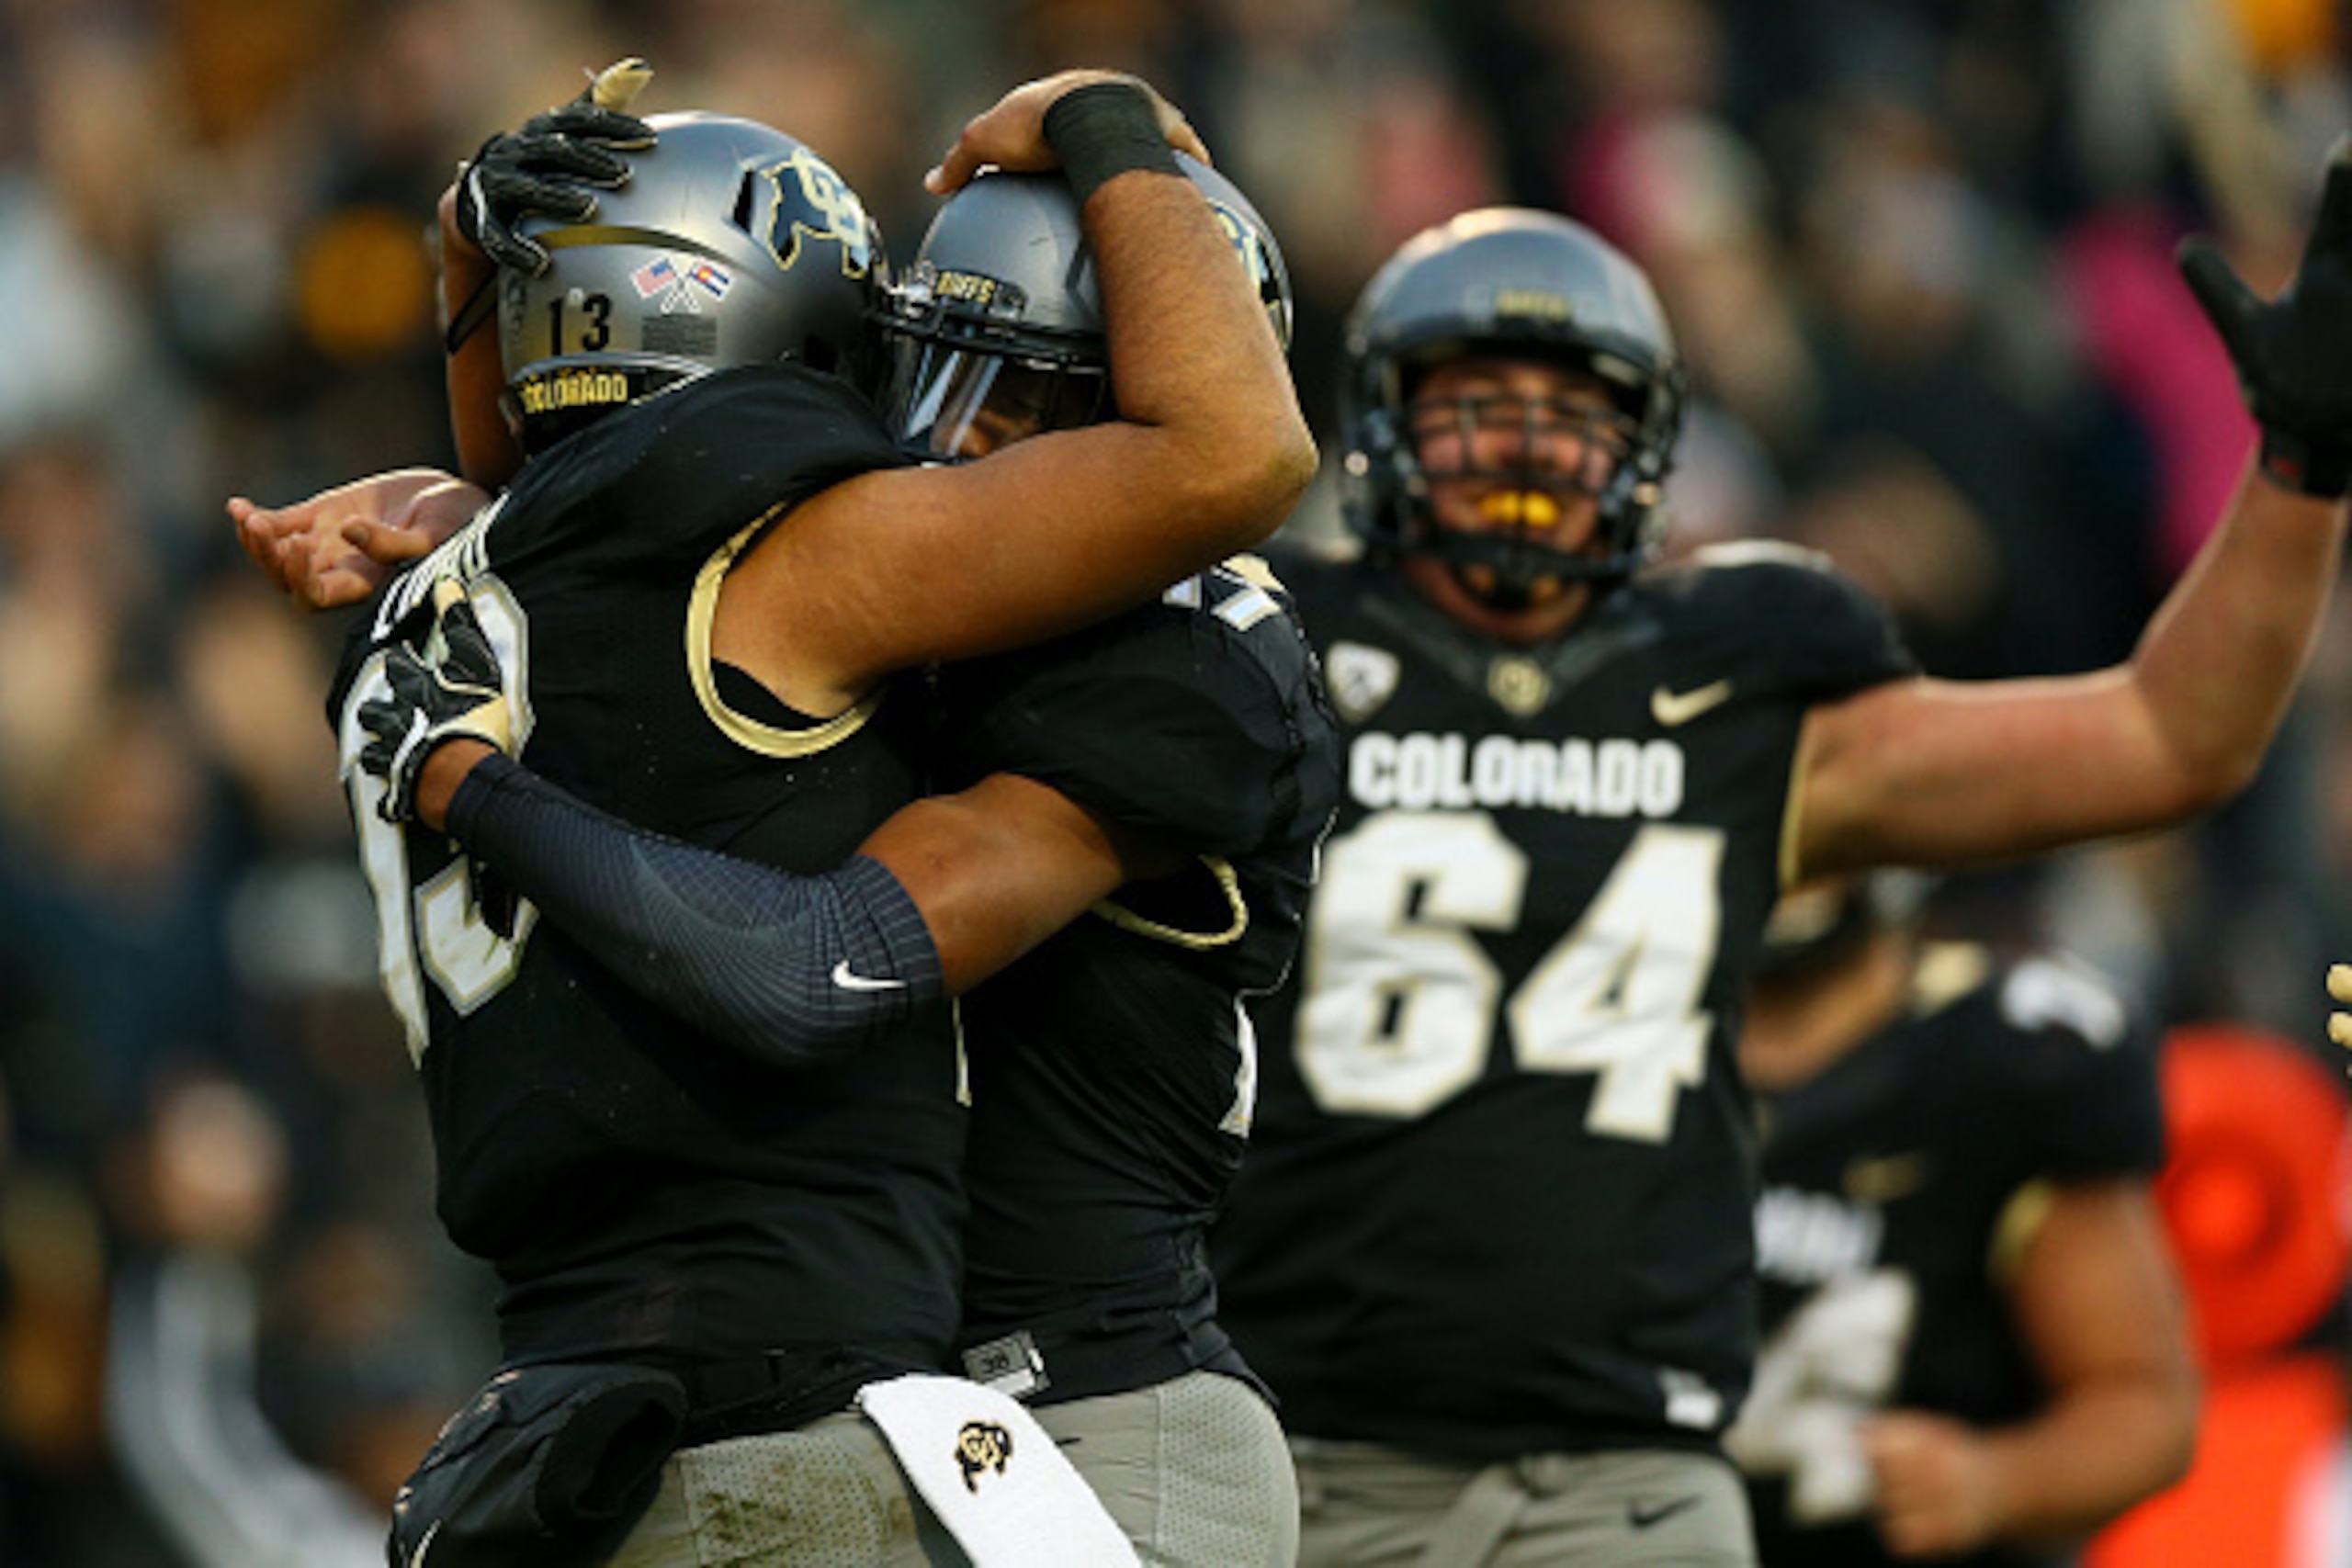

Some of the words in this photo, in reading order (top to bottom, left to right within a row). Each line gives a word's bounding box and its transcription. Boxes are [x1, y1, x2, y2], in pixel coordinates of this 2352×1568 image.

[548, 292, 612, 356] 13
[1348, 732, 1685, 818] COLORADO
[1294, 808, 1727, 1144] 64
